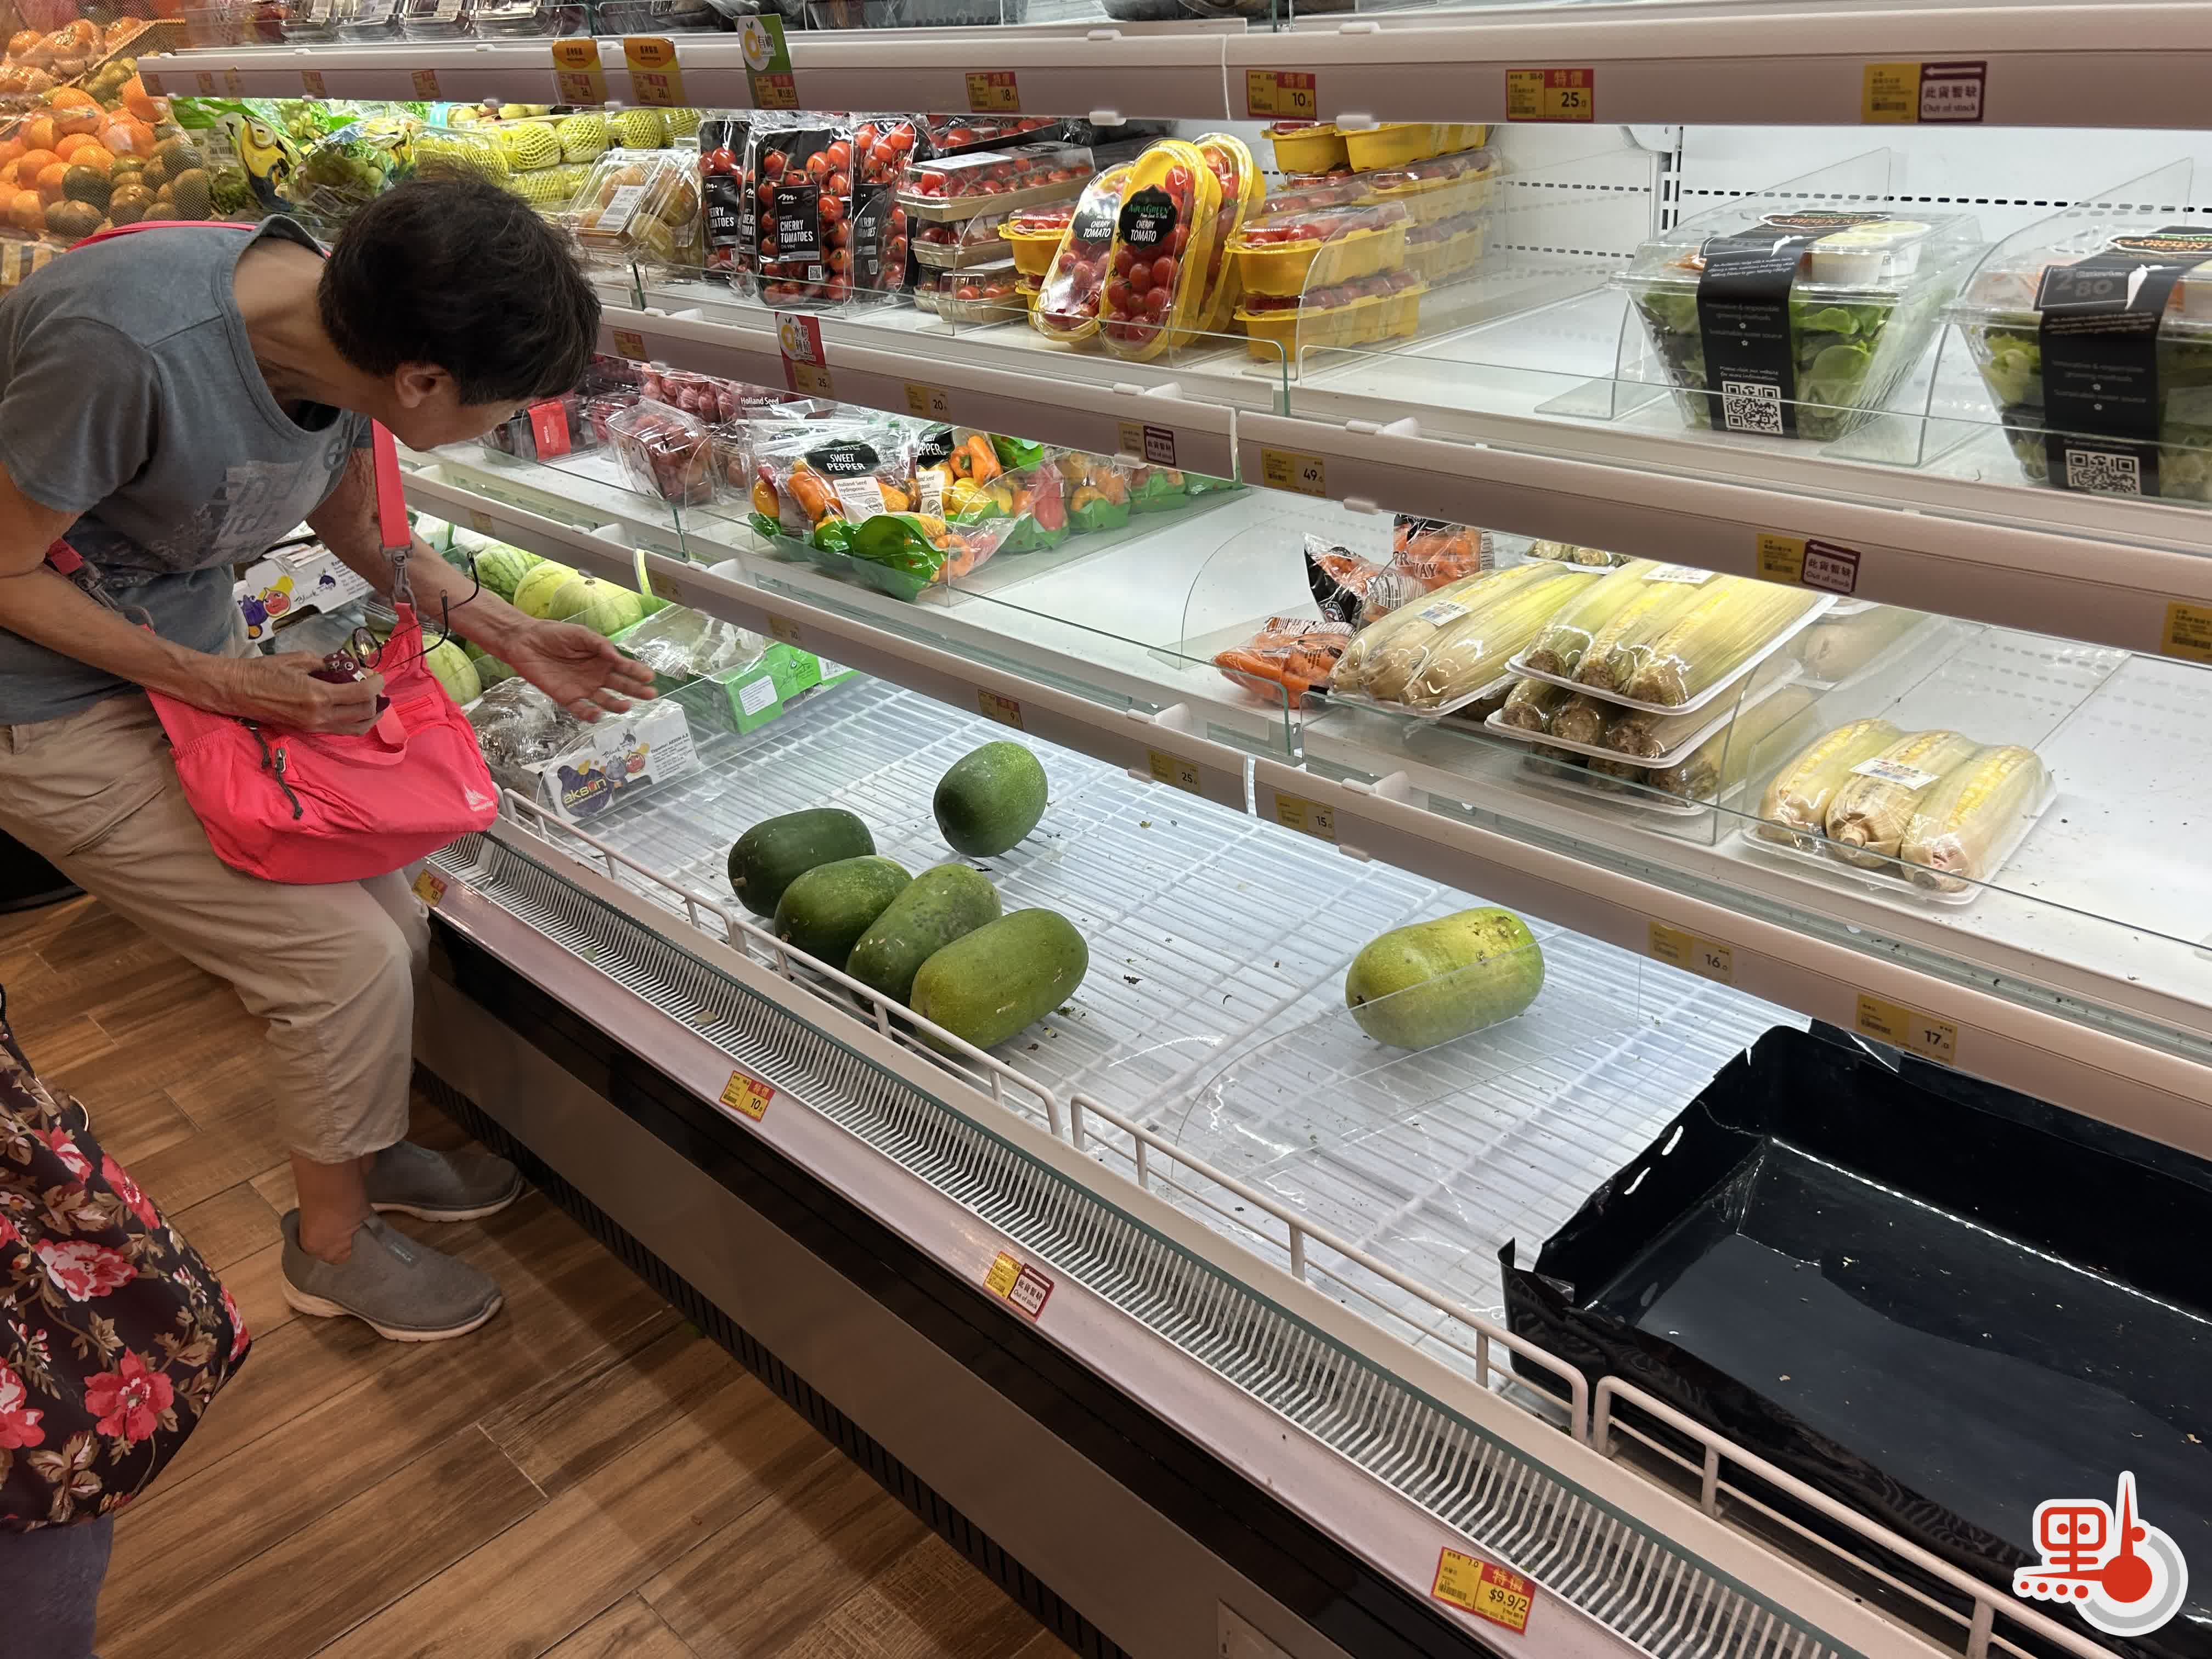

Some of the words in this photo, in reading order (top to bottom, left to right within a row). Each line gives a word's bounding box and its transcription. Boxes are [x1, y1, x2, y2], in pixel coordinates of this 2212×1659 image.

[1925, 86, 1977, 98] 此貨暫缺
[1923, 104, 1940, 112] Out
[1953, 103, 1976, 111] stock
[780, 220, 804, 232] CHERRY
[1090, 221, 1110, 229] CHERRY
[1136, 219, 1155, 229] CHERRY
[781, 231, 814, 244] TOMATOES
[1083, 228, 1111, 238] TOMATO
[1130, 229, 1156, 242] TOMATO
[740, 397, 764, 405] Holland
[764, 397, 779, 405] Seed
[830, 453, 855, 463] SWEET
[826, 462, 866, 471] PEPPER
[1808, 558, 1851, 577] 此貨暫缺
[1705, 953, 1728, 971] 16.0
[754, 1083, 770, 1098] 特價
[1018, 1279, 1042, 1301] 此貨暫缺
[1013, 1289, 1022, 1297] Out
[1026, 1298, 1037, 1310] stock
[1468, 1558, 1479, 1568] 7.0
[1492, 1567, 1525, 1593] 特價
[1488, 1588, 1527, 1613] $9.9/2
